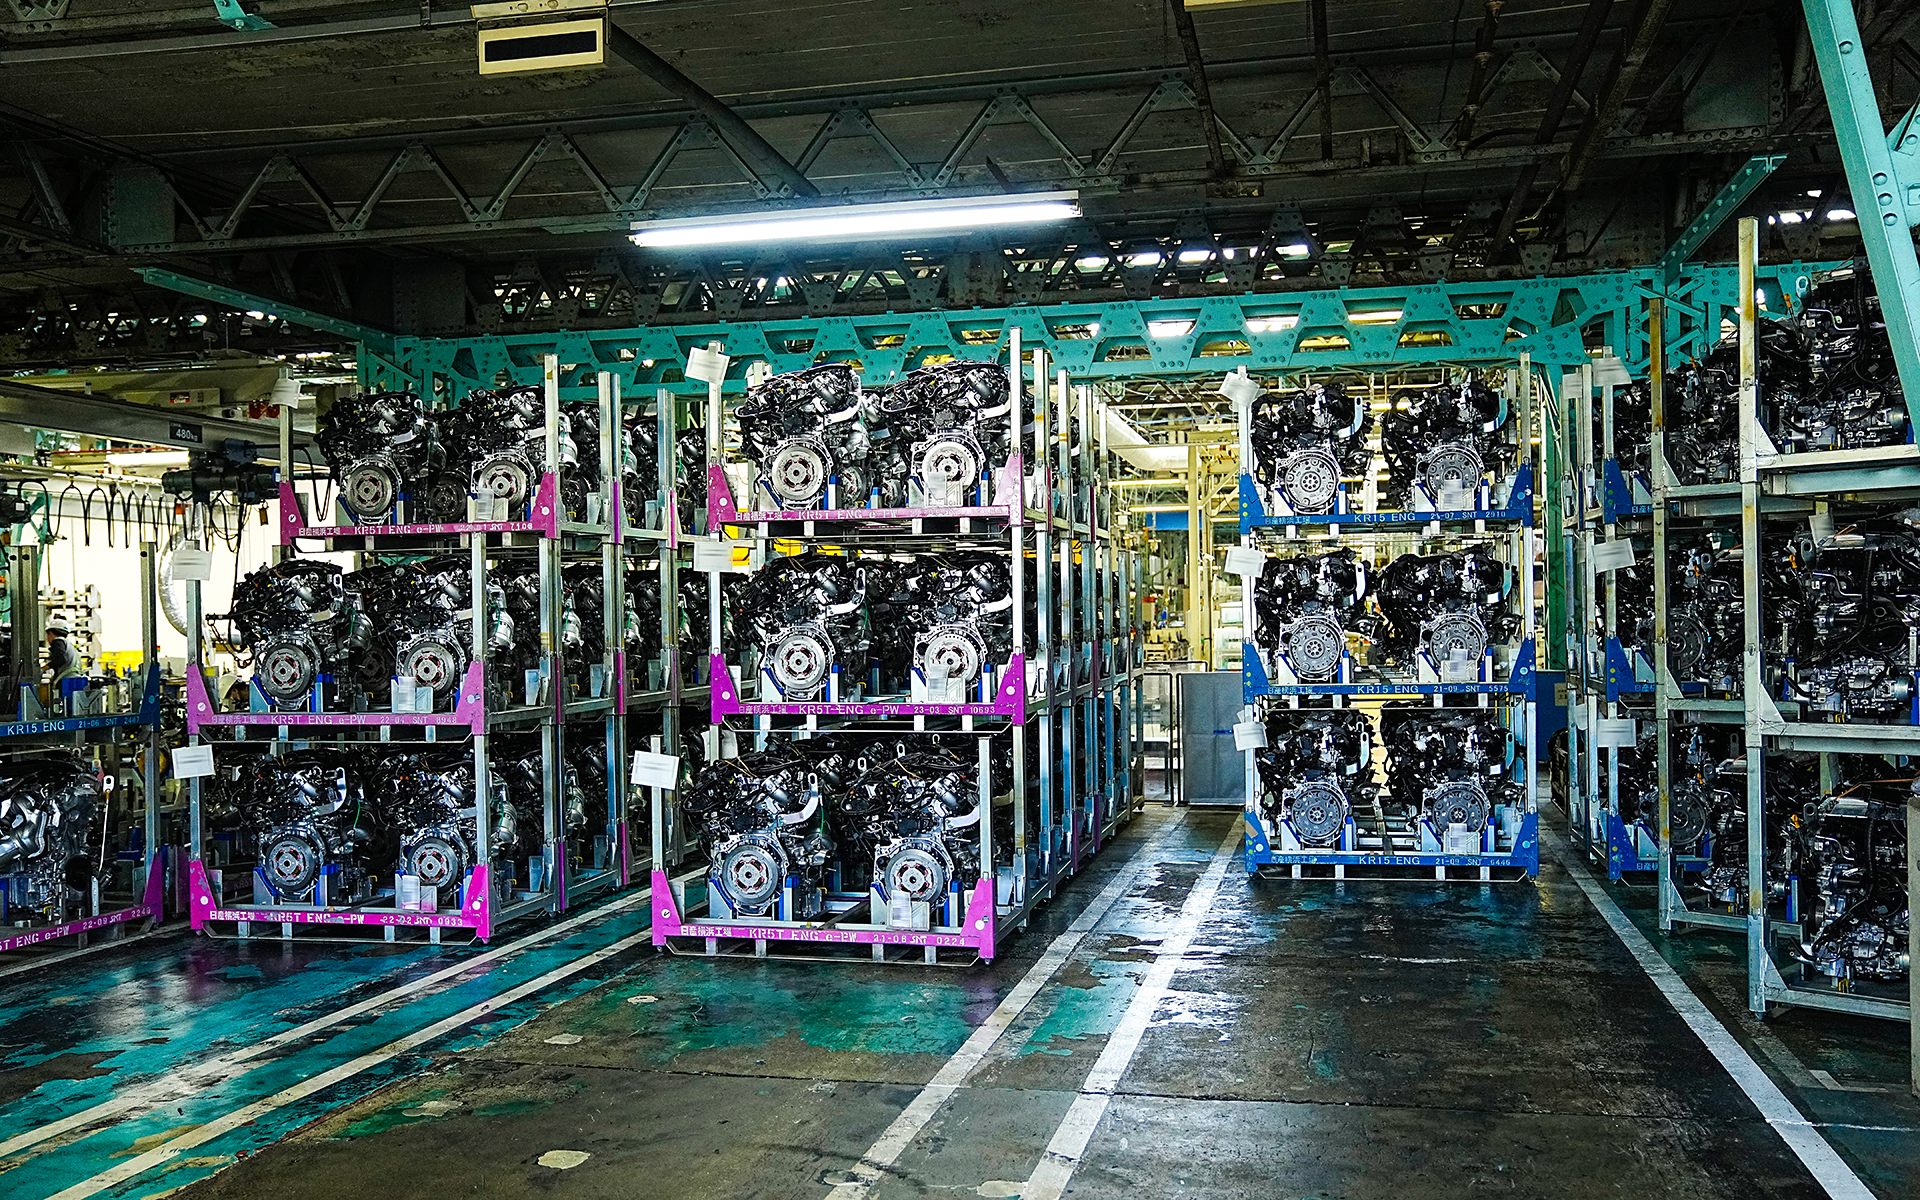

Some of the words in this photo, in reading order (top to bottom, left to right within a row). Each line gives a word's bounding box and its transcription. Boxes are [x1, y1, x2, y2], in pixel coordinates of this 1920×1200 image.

[798, 511, 830, 520] KR5T
[837, 510, 862, 519] ENG
[1354, 514, 1385, 522] KR15
[354, 526, 383, 535] KR5T
[388, 525, 411, 534] ENG
[914, 706, 940, 714] 23-03
[948, 706, 965, 714] SNT
[970, 706, 995, 714] 10693
[271, 715, 302, 724] KR5T
[308, 715, 332, 724] ENG
[339, 716, 366, 724] e-PW
[380, 716, 405, 724] 22-04
[412, 716, 428, 724] SNT
[436, 716, 457, 724] 8948
[8, 724, 37, 735] KR15
[43, 721, 65, 732] ENG
[78, 721, 100, 729] 21-06
[1359, 856, 1390, 864] KR15
[1396, 856, 1420, 865] ENG
[438, 918, 463, 926] 0933
[16, 933, 39, 947] ENG
[45, 926, 70, 940] e-PW
[749, 928, 785, 939] KR5T
[791, 930, 819, 941] ENG
[936, 936, 965, 946] 0224
